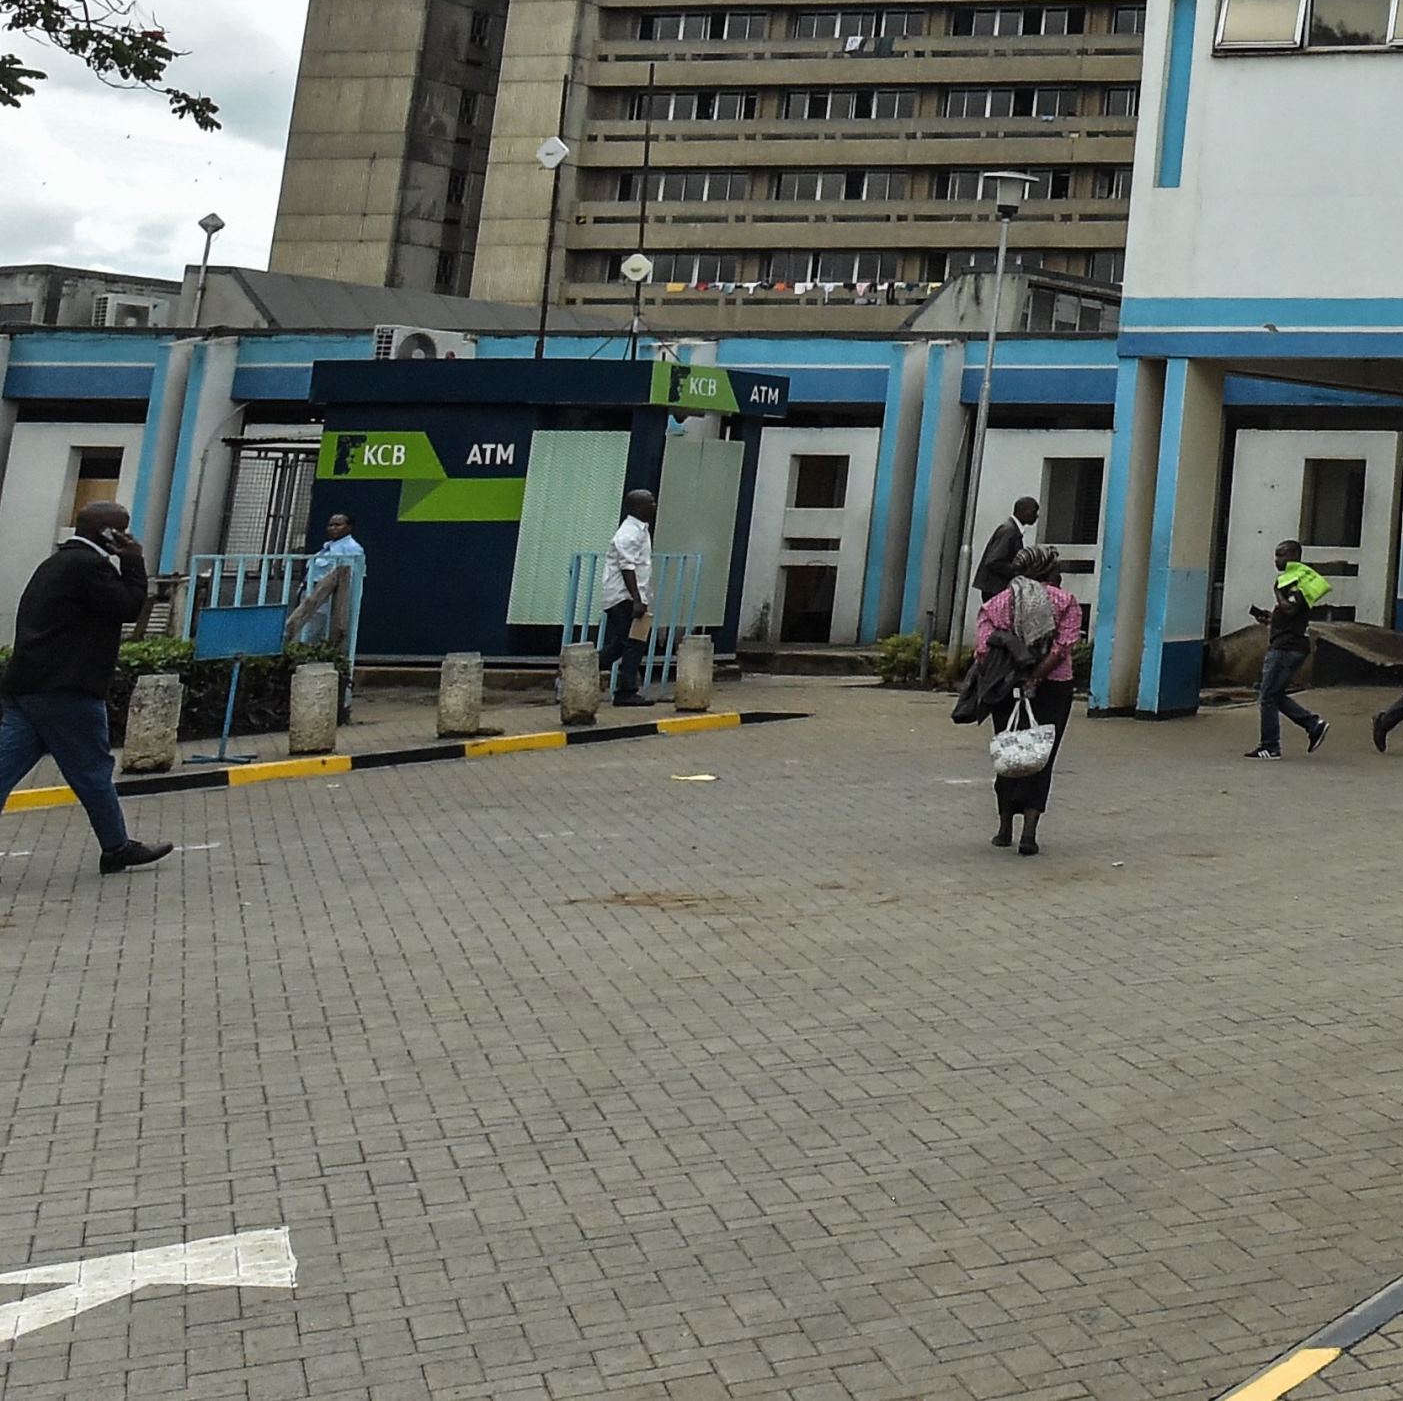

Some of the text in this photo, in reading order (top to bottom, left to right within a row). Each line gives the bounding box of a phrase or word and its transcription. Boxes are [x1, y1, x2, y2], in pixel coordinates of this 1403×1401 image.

[690, 377, 779, 404] KCB ATM
[363, 443, 515, 466] KCB ATM
